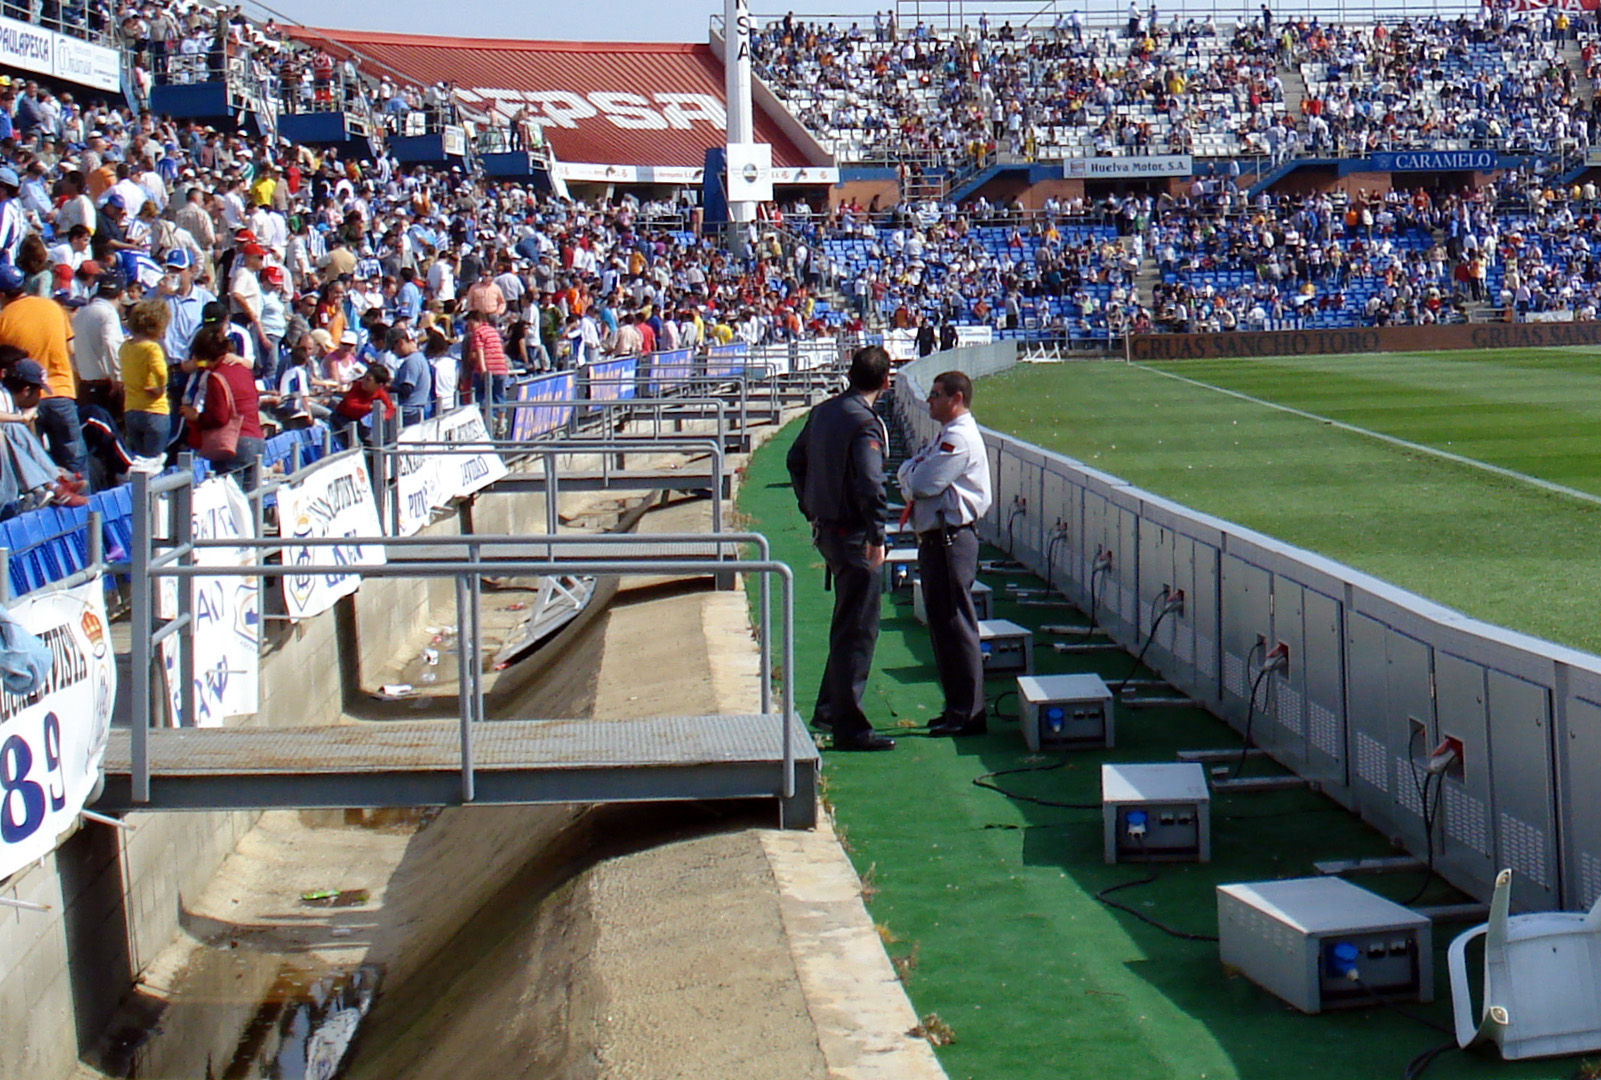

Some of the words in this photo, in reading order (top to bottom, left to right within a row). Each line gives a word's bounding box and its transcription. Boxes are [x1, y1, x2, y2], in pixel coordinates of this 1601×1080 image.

[1091, 162, 1129, 172] Huelva
[1395, 152, 1491, 171] CARAMELO
[1133, 335, 1207, 360] GRUAS
[1213, 332, 1309, 357] SANCHO
[1314, 330, 1379, 354] TORO
